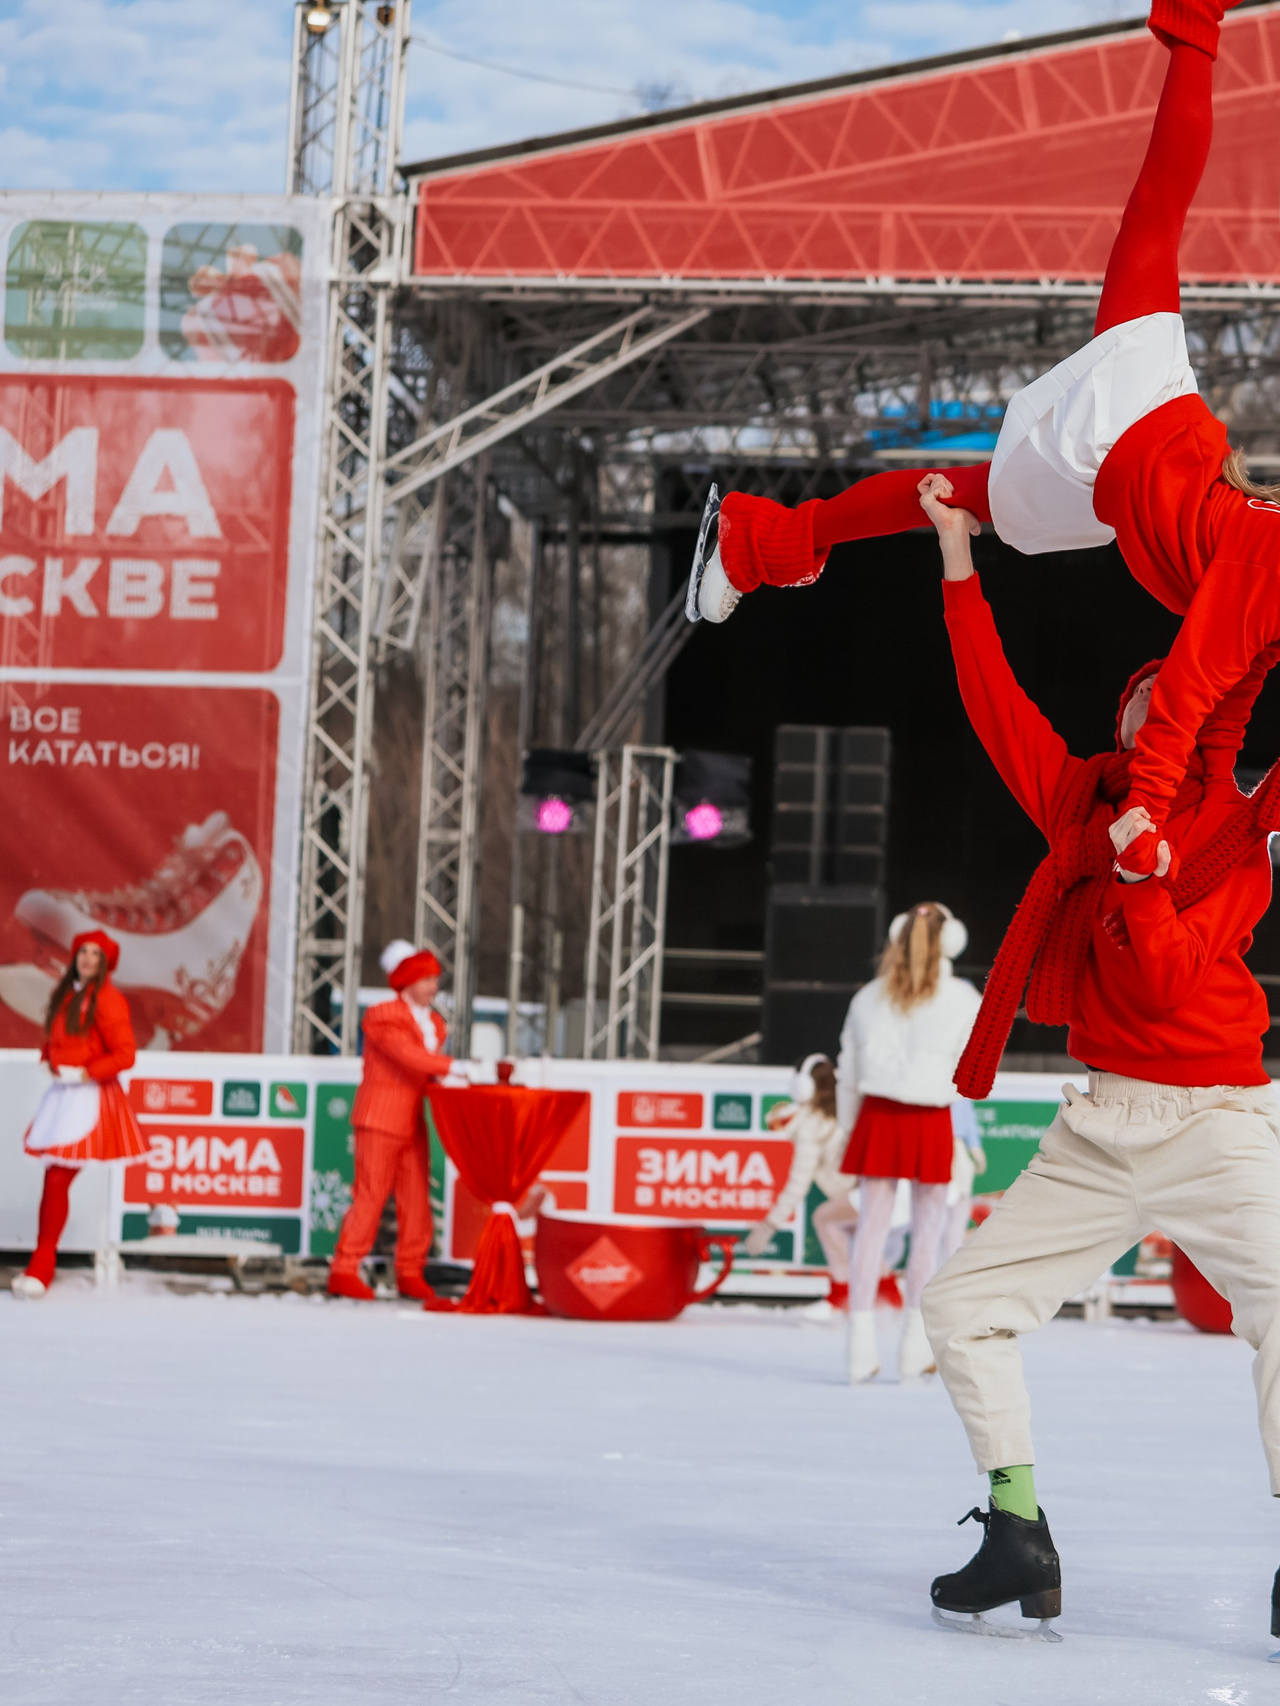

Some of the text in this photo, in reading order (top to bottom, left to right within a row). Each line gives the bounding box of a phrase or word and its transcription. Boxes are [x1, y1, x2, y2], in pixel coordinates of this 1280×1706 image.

[146, 1135, 283, 1174] ЗИМА
[635, 1148, 776, 1186] ЗИМА
[145, 1171, 282, 1197] В МОСКВЕ
[635, 1185, 774, 1209] В МОСКВЕ
